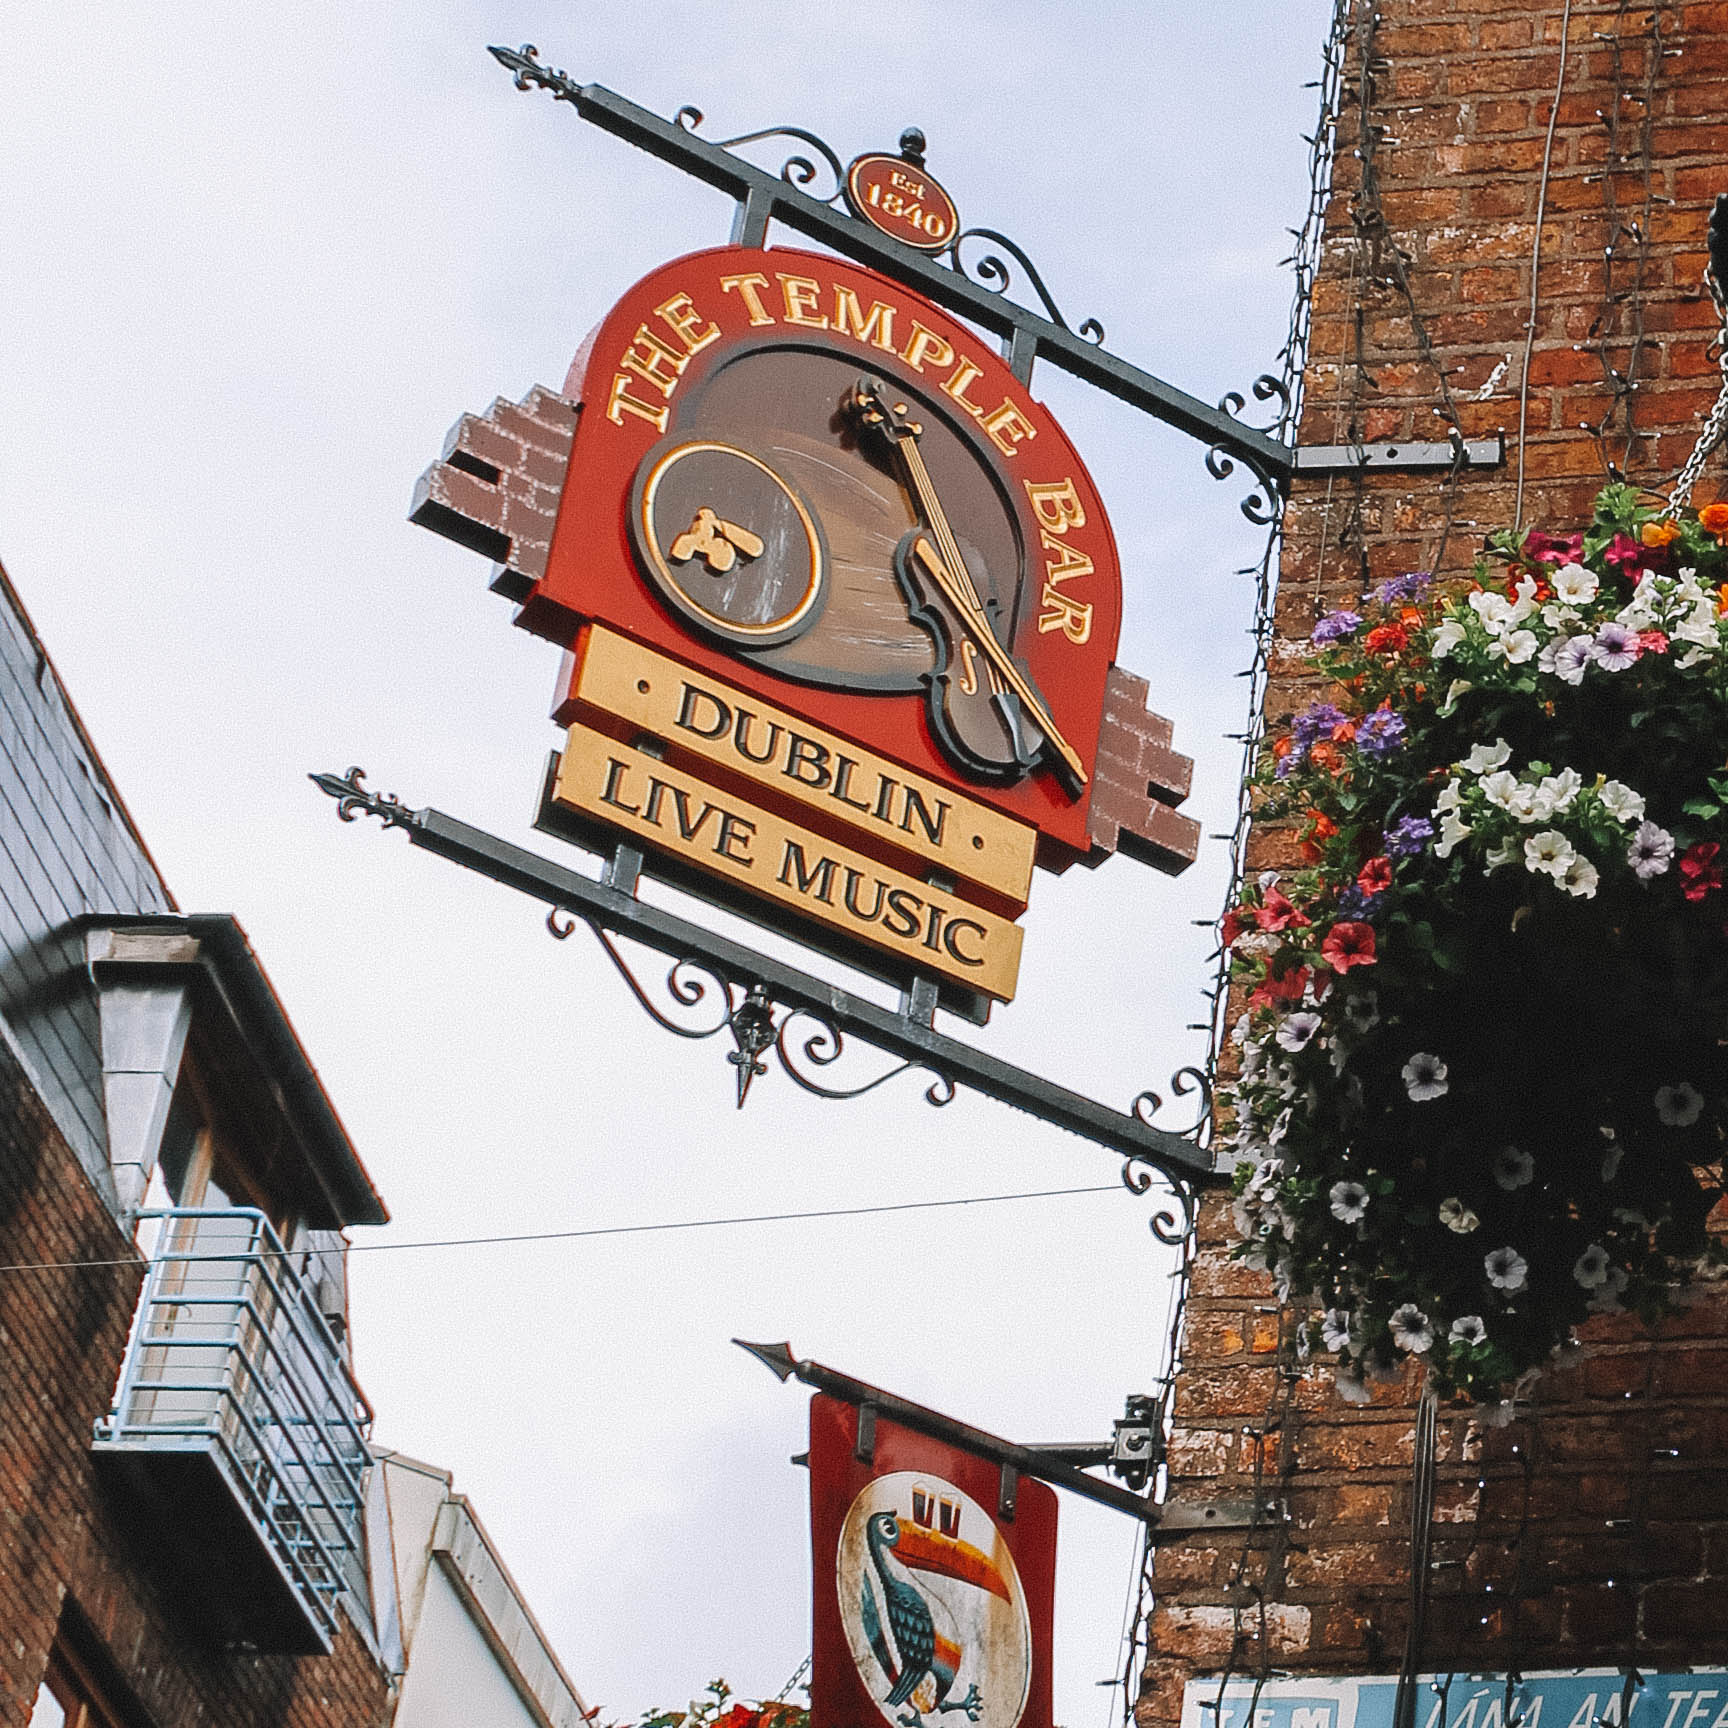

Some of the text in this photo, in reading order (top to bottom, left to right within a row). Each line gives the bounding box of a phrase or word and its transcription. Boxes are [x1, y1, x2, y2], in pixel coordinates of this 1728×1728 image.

[865, 181, 946, 239] 1840
[889, 168, 926, 201] Est
[605, 271, 1096, 646] THE TEMPLE BAR
[673, 680, 953, 848] DUBLIN
[599, 757, 989, 968] LIVE MUSIC
